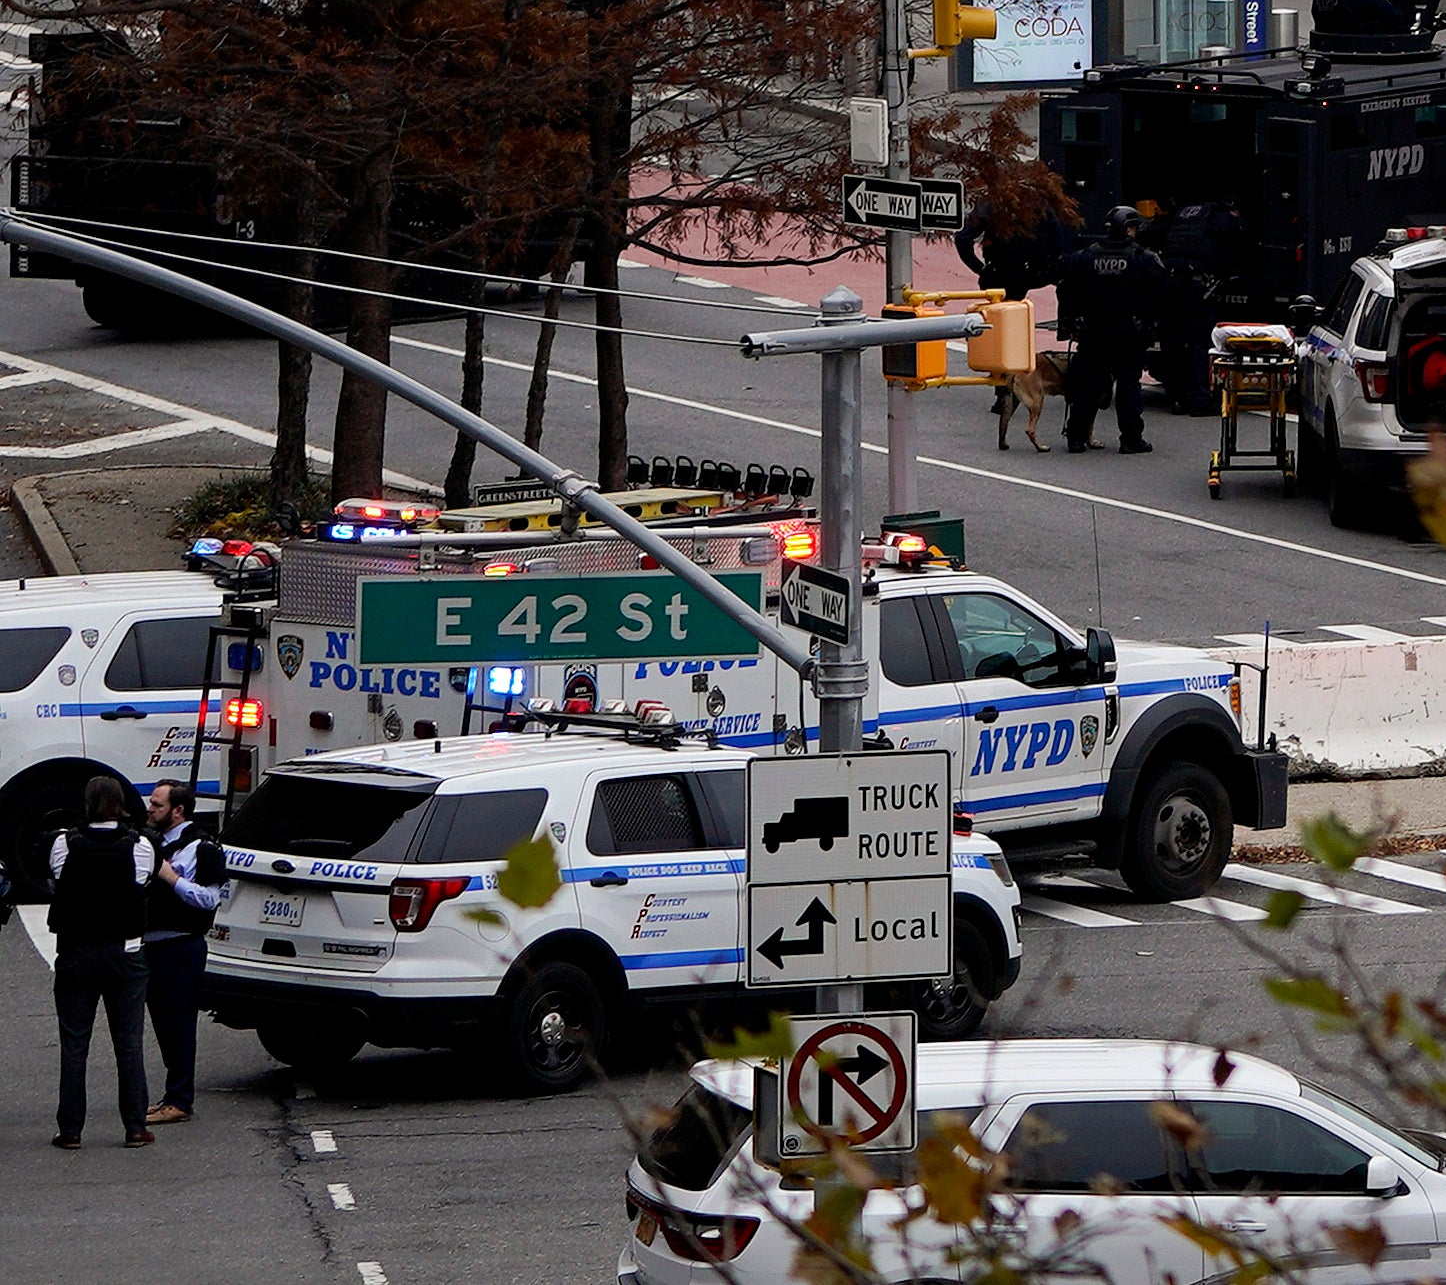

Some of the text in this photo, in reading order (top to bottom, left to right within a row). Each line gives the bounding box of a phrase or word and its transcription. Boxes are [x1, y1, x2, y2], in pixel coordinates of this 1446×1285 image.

[1014, 16, 1084, 38] CODA
[1246, 1, 1258, 44] Street
[1360, 93, 1431, 113] EMERGENCY SERVICE
[1367, 143, 1425, 181] NYPD
[855, 191, 914, 216] ONE WAY
[922, 193, 954, 214] WAY
[1094, 258, 1128, 272] NYPD
[478, 488, 556, 506] GREENSTREETS
[787, 579, 845, 622] ONE WAY
[436, 591, 690, 646] E 42 St
[309, 659, 441, 699] POLICE
[1185, 675, 1220, 692] POLICE
[36, 704, 58, 718] CRC
[165, 726, 220, 741] COURESY
[712, 713, 761, 736] SERVICE
[970, 718, 1075, 777] NYPD
[857, 782, 940, 812] TRUCK
[857, 830, 940, 860] ROUTE
[309, 861, 379, 882] POLICE
[627, 862, 728, 878] POLICE DOG KEEP BACK
[484, 874, 500, 890] 52
[262, 898, 290, 917] 5280
[854, 911, 939, 943] Local
